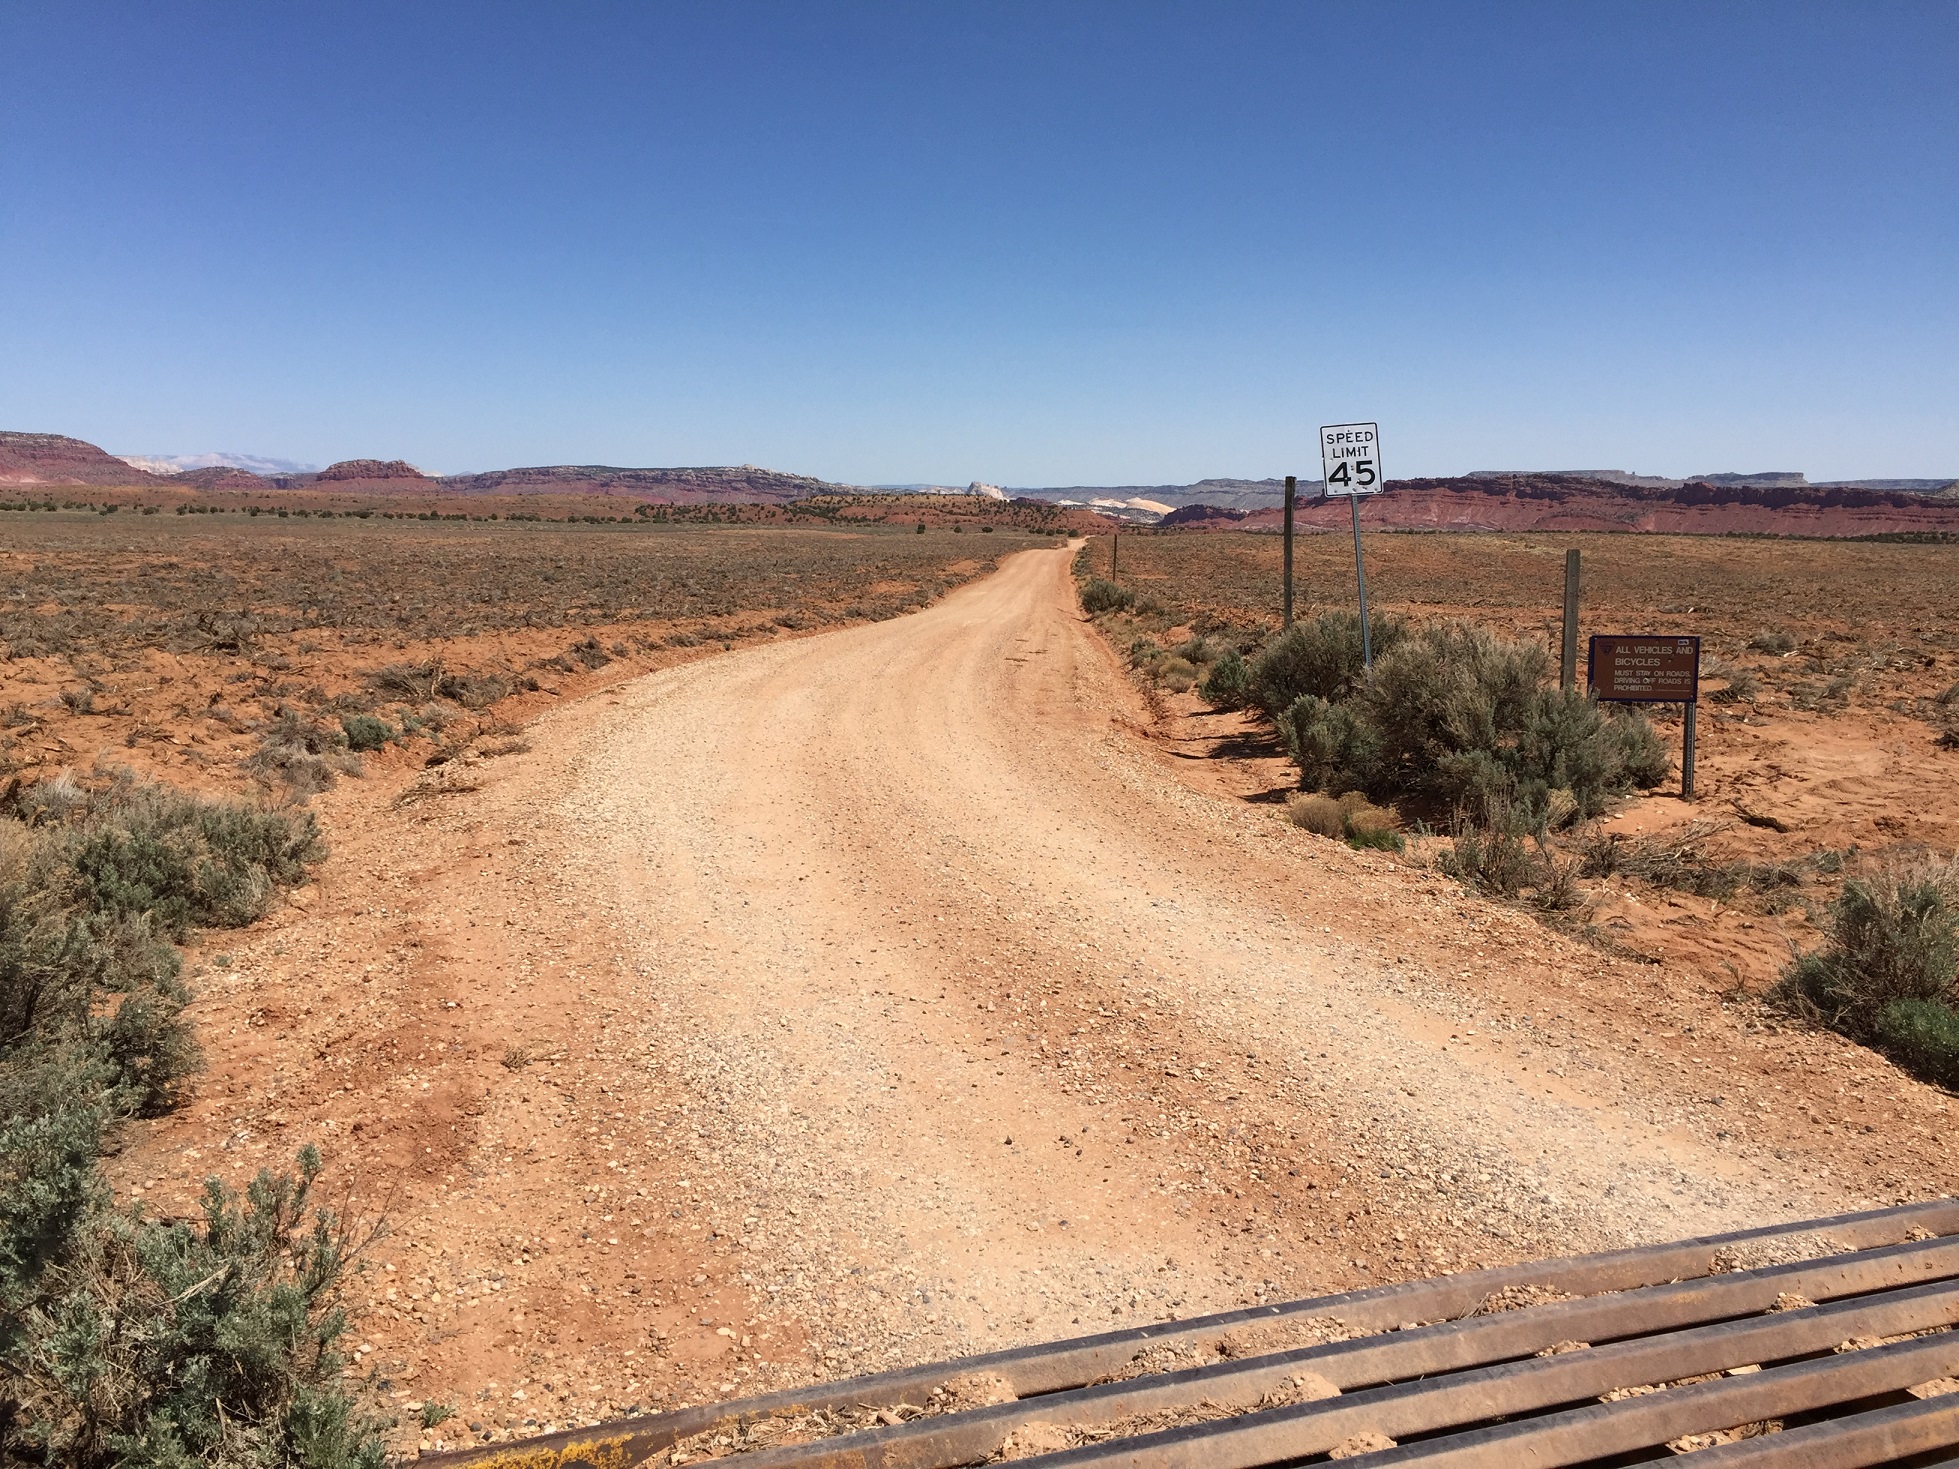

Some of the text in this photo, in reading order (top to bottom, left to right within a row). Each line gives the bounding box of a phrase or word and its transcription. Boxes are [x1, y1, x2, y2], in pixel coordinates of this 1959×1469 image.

[1326, 431, 1373, 444] SPEED
[1332, 446, 1369, 458] LIMIT
[1328, 460, 1376, 487] 45
[1615, 646, 1694, 655] ALL VEHICLES AND
[1615, 658, 1661, 666] BICYCLES
